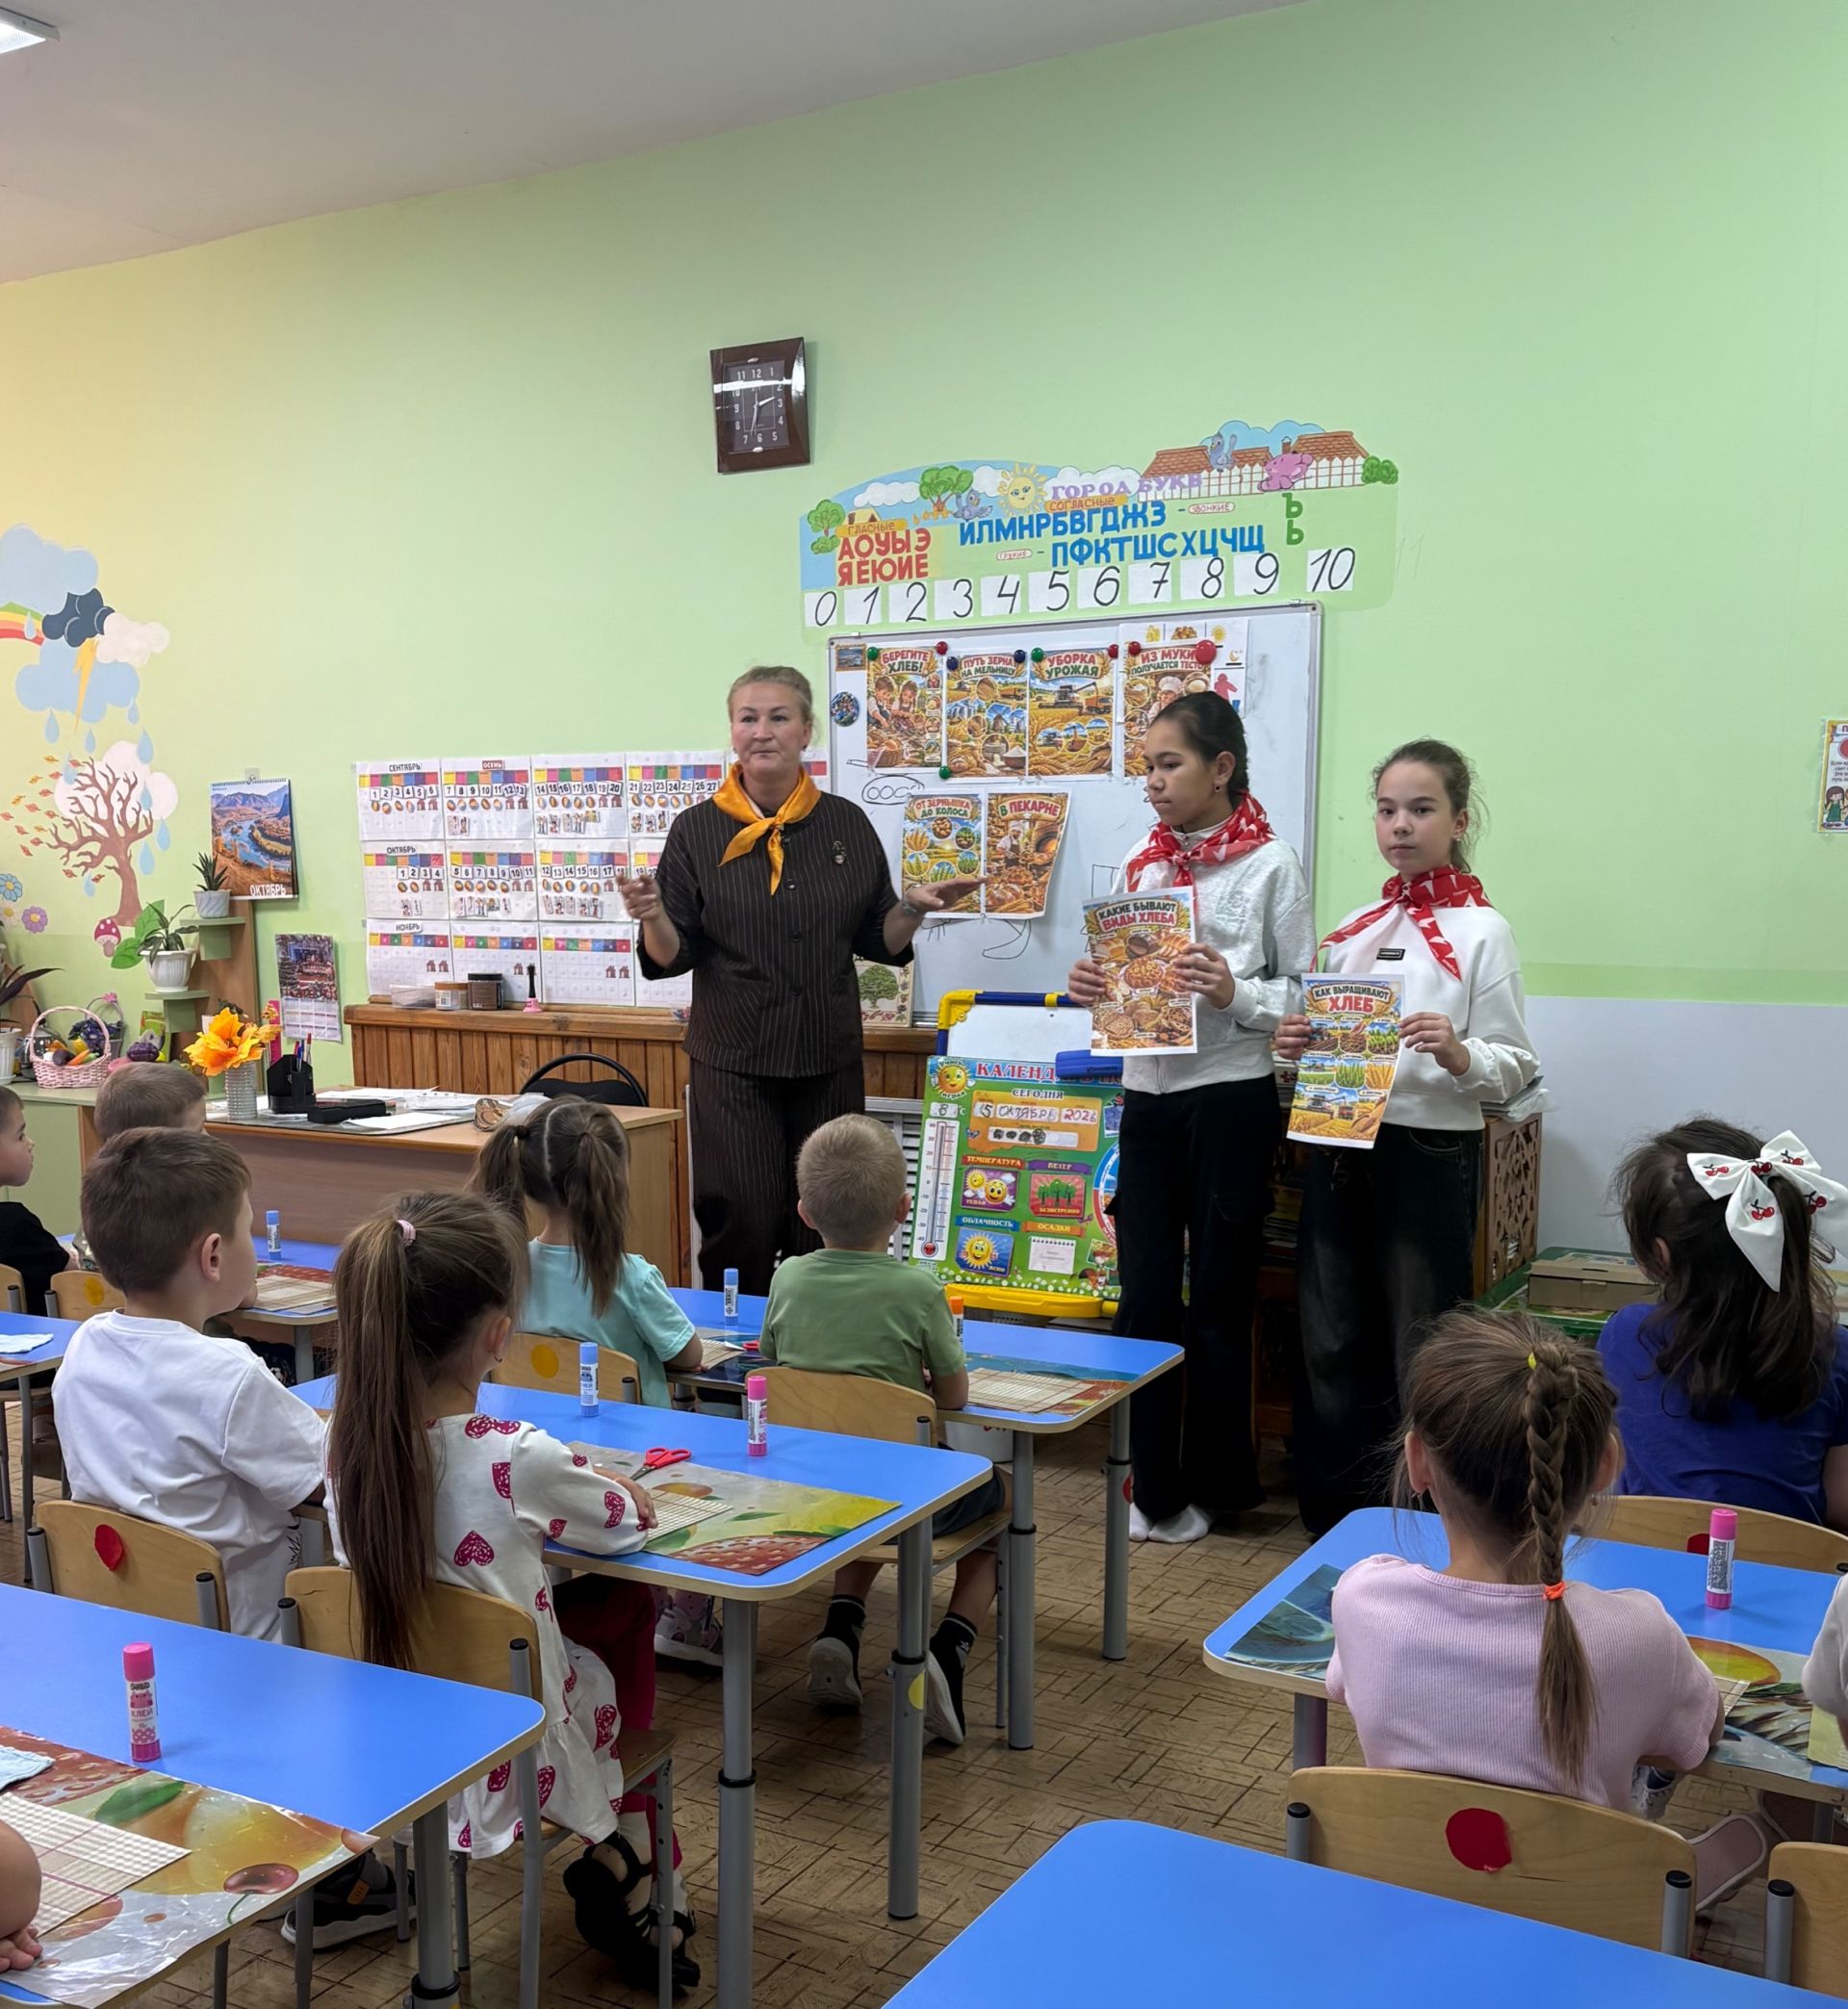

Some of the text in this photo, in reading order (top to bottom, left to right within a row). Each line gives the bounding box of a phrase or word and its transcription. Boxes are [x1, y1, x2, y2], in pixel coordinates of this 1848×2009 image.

[737, 371, 746, 380] 11
[752, 369, 762, 378] 12
[770, 367, 774, 376] 1
[733, 404, 739, 413] 9
[778, 399, 783, 408] 3
[735, 422, 740, 430] 8
[778, 416, 783, 425] 4
[743, 435, 748, 445] 7
[757, 433, 762, 443] 6
[772, 431, 778, 441] 5
[1139, 473, 1202, 492] БУКВ
[1282, 492, 1303, 519] Ъ
[1286, 520, 1304, 546] Ь
[815, 548, 1355, 626] 0 1 2 3 4 5 6 7 8 9 10
[883, 650, 928, 663] БЕРЕГИТЕ
[1047, 655, 1096, 667] УБОРКА
[1142, 648, 1196, 663] ИЗ МУКИ
[888, 660, 923, 673] ХЛЕБ!
[963, 657, 1013, 668] ПУТЬ ЗЕРНА
[1131, 658, 1204, 676] ПОЛУЧАЕТСЯ ТЕСТО
[975, 666, 1015, 676] МЕЛЬНИЦУ
[1045, 665, 1099, 678] УРОЖАЯ
[389, 762, 421, 772] СЕНТЯБРЬ
[516, 786, 525, 795] 13
[559, 785, 569, 793] 16
[585, 784, 594, 793] 18
[599, 785, 606, 793] 19
[610, 785, 620, 793] 20
[696, 782, 705, 790] 26
[916, 798, 970, 810] ОТ ЗЕРНЫШКА
[1000, 799, 1060, 816] В ПЕКАРНЕ
[921, 807, 968, 817] ДО КОЛОСА
[387, 846, 416, 855] ОКТЯБРЬ
[400, 868, 405, 877] 1
[250, 885, 286, 896] ОКТЯБРЬ
[1098, 902, 1176, 919] КАКИЕ БЫВАЮТ
[1102, 912, 1174, 931] ВИДЫ ХЛЕБА
[396, 923, 421, 932] НОЯБРЬ
[1315, 986, 1389, 999] КАК ВЫРАЩИВАЮТ
[1328, 995, 1373, 1013] ХЛЕБ
[1012, 1089, 1064, 1099] СЕГОДНЯ
[999, 1105, 1056, 1120] ОКТЯБРЬ
[967, 1156, 1021, 1167] ТЕМПЕРАТУРА
[962, 1217, 1014, 1227] ОБЛАЧНОСТЬ
[1038, 1223, 1071, 1232] ОСАДКИ
